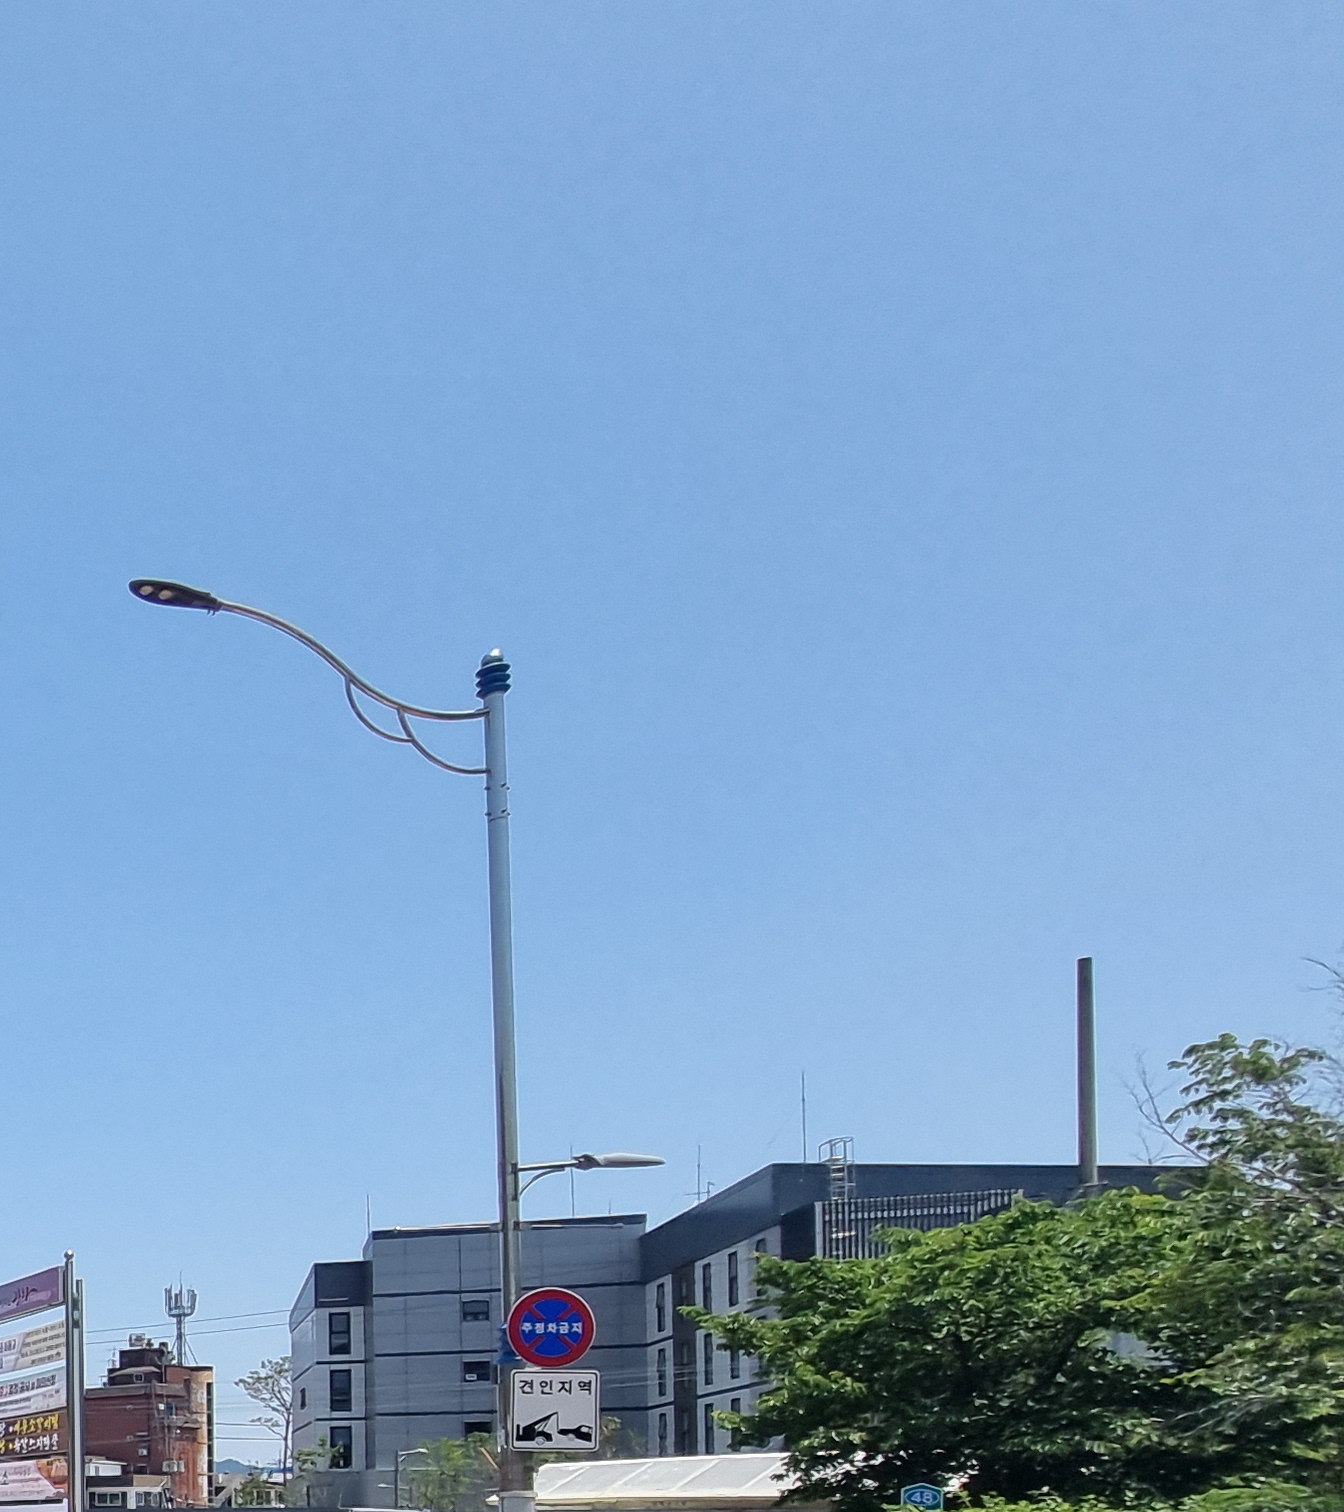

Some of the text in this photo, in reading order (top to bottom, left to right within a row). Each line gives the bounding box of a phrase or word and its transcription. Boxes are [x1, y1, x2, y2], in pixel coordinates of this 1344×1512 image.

[520, 1322, 583, 1334] 주정차금지
[519, 1379, 593, 1396] 견인지역
[911, 1491, 933, 1504] 48
